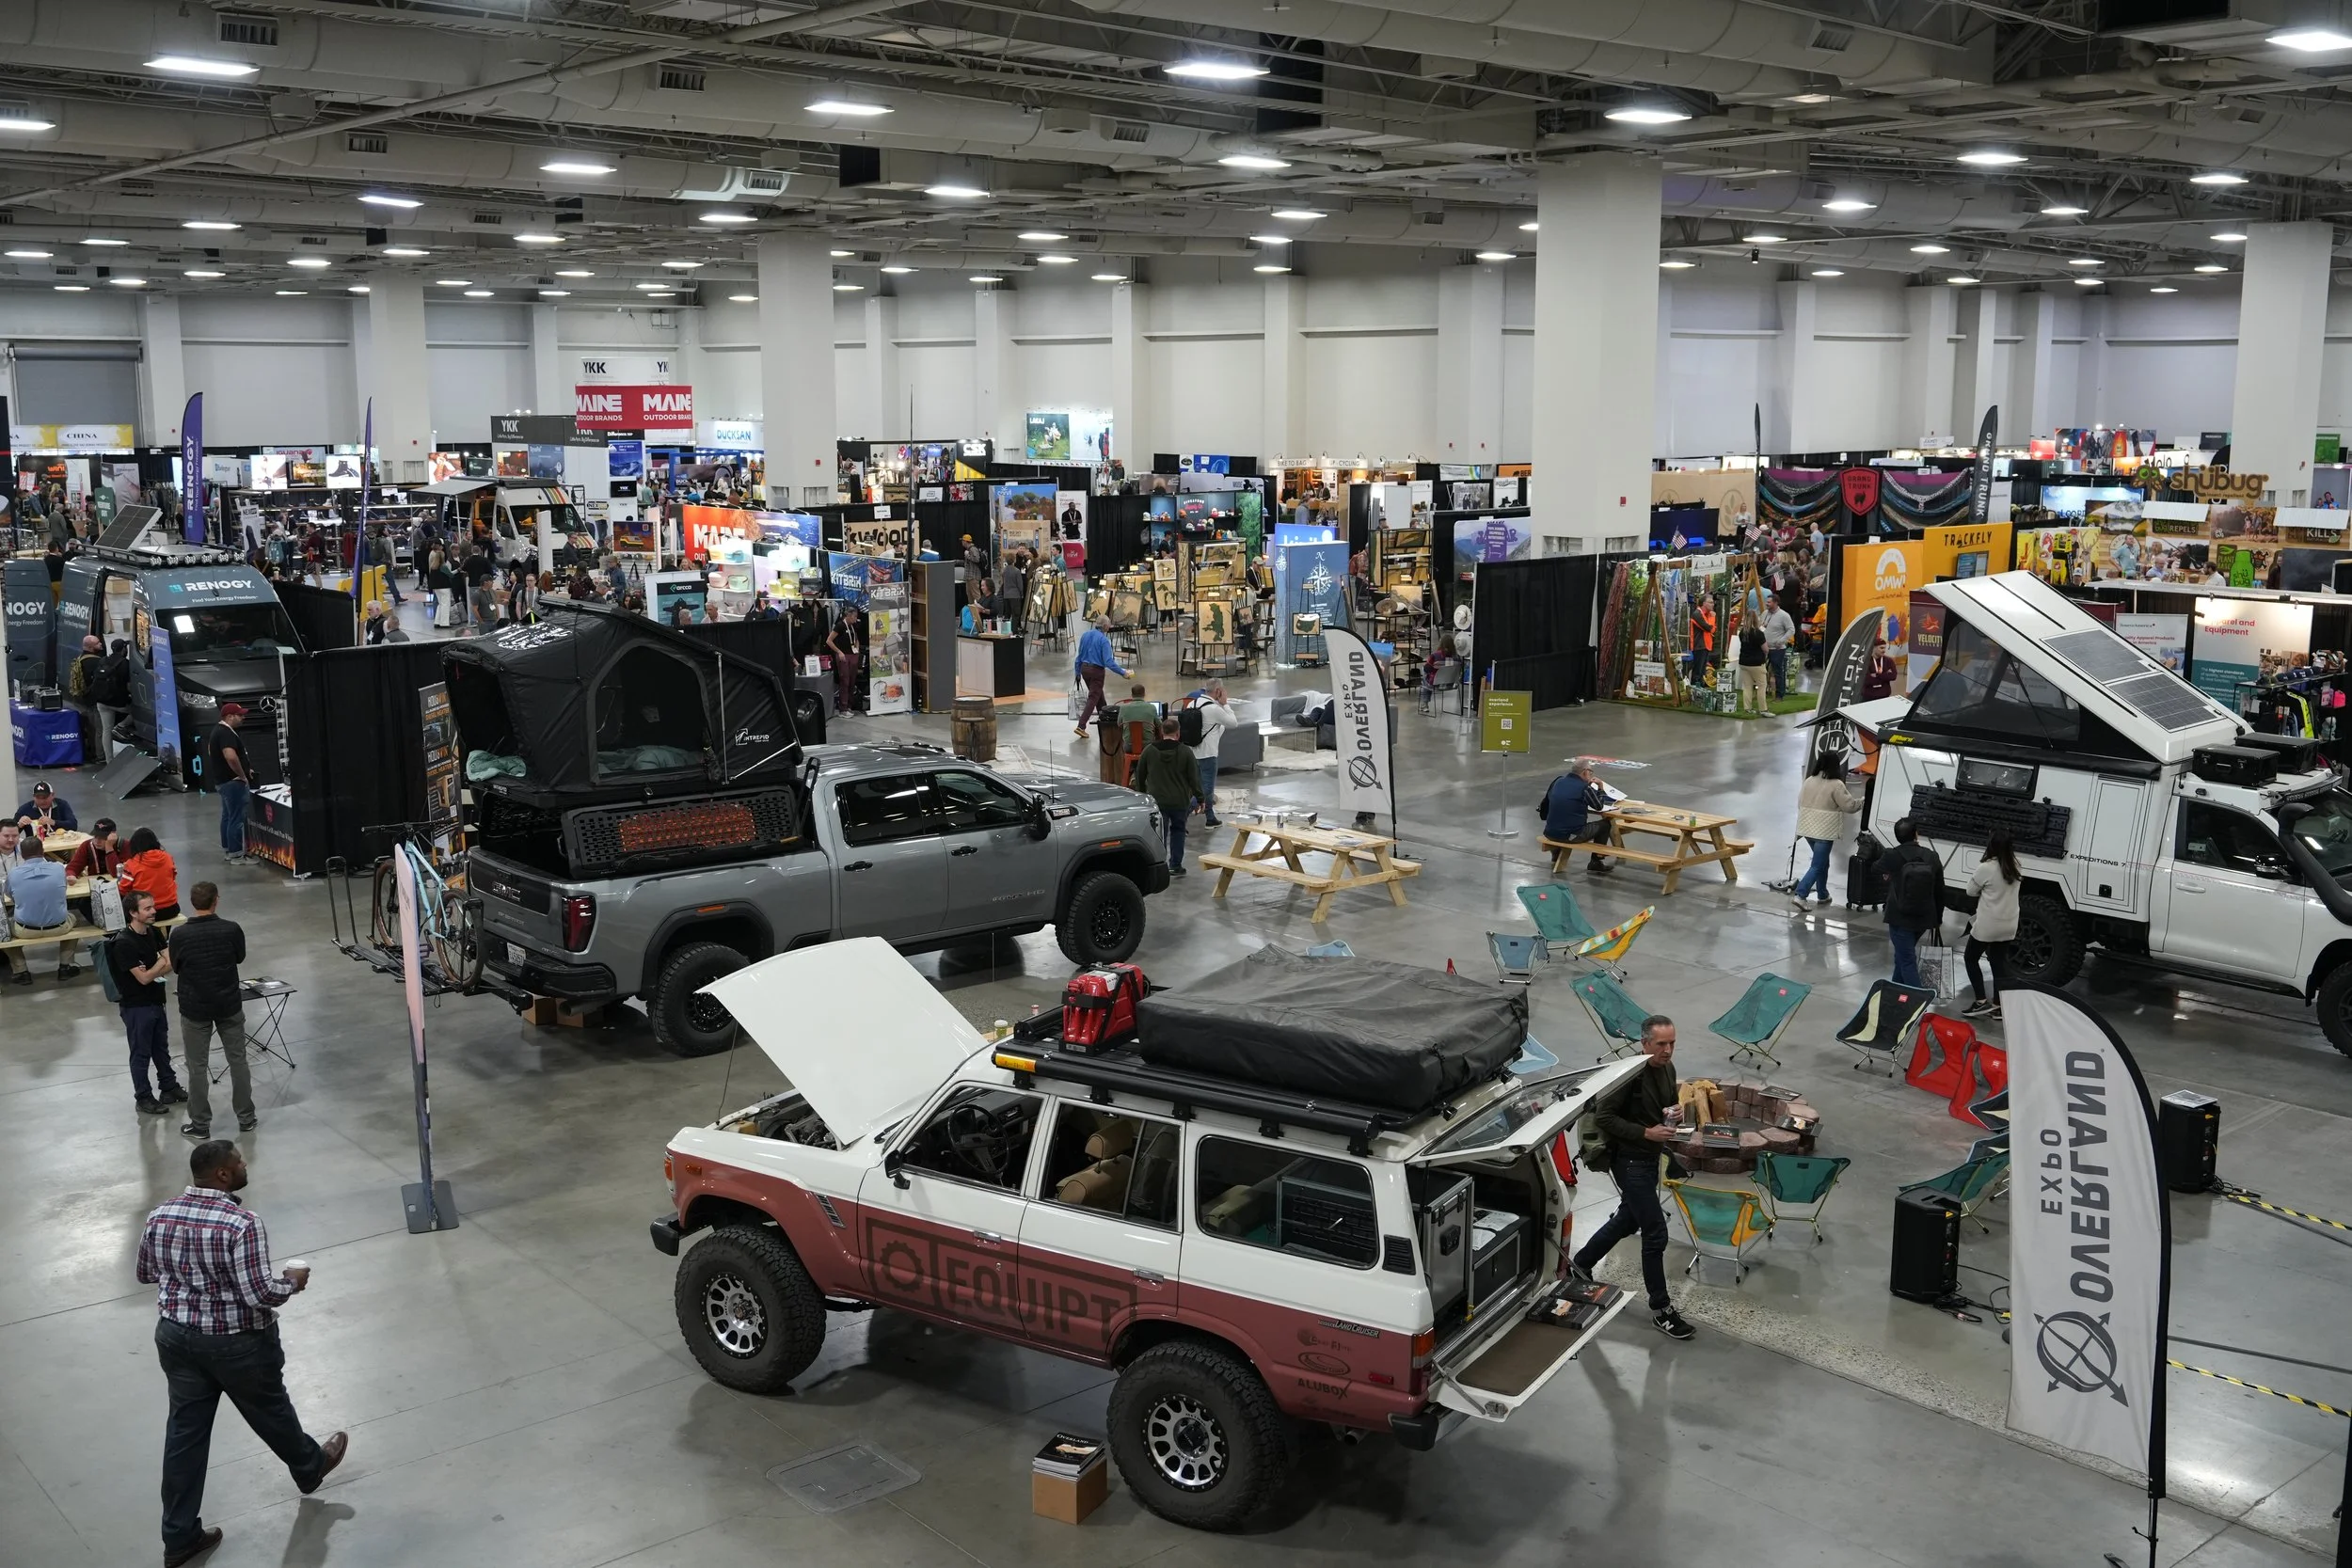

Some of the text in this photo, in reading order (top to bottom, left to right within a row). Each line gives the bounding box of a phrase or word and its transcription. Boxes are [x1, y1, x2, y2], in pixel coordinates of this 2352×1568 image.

[583, 362, 606, 373] YKK
[657, 362, 668, 372] YK
[501, 420, 518, 432] YKK
[716, 429, 751, 440] DUCKSAN
[1976, 477, 1989, 517] TRUNK
[2169, 525, 2196, 534] REPELS
[184, 579, 252, 592] RENOGY
[1874, 575, 1907, 592] OMW!
[64, 601, 89, 619] RENOGY
[2204, 626, 2249, 636] Equipment
[51, 732, 78, 740] RENOGY
[2070, 853, 2119, 866] EXPEDITIONS
[492, 880, 521, 902] GMC
[946, 1257, 1120, 1344] EQUIPT
[1351, 1323, 1379, 1338] CRUISER
[1297, 1378, 1353, 1400] ALUBOX
[1057, 1433, 1089, 1444] OVERLAND
